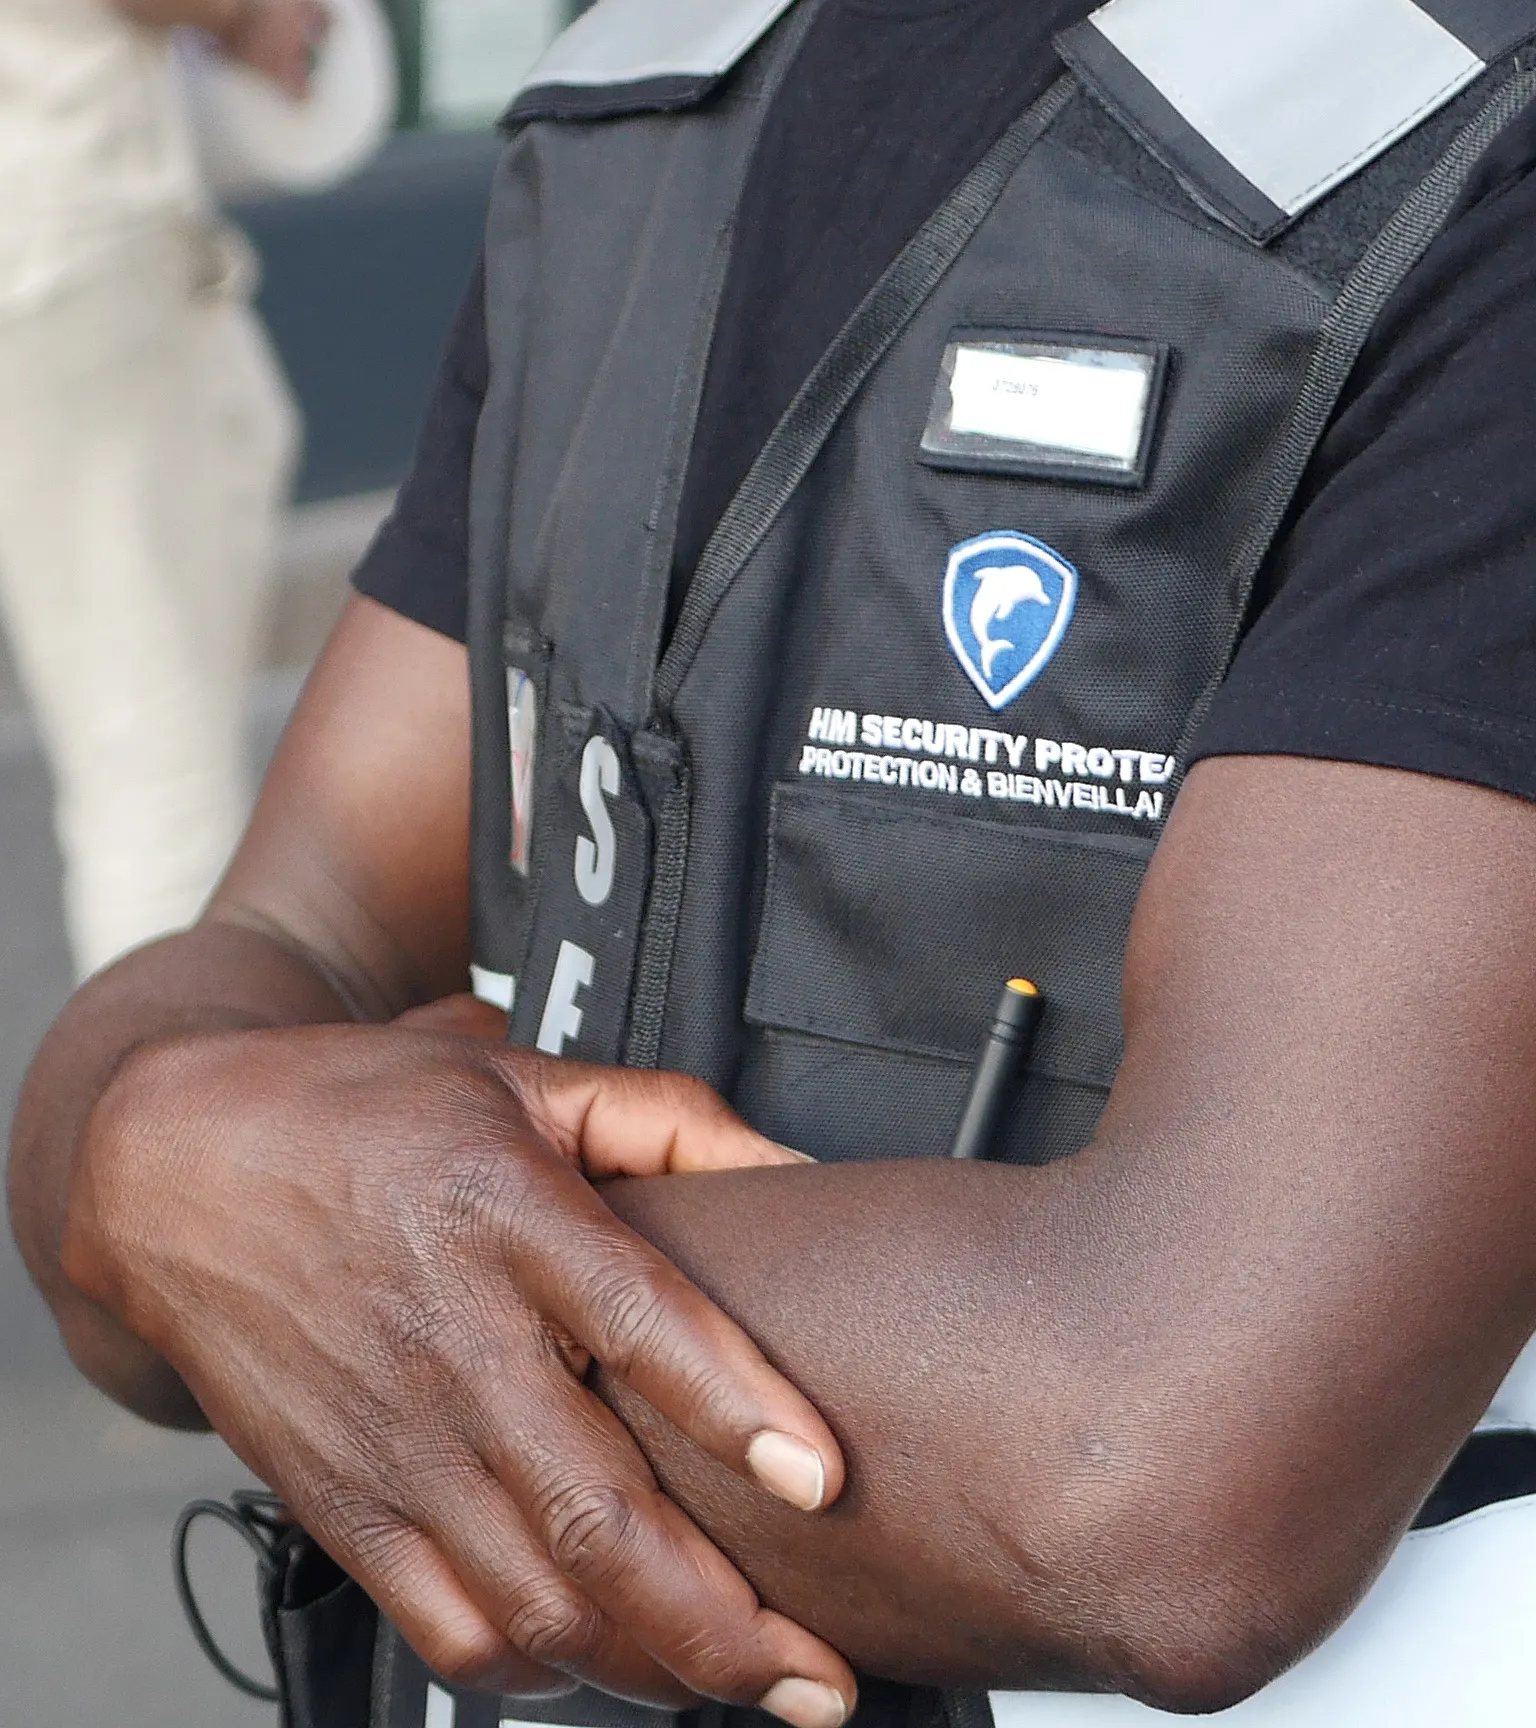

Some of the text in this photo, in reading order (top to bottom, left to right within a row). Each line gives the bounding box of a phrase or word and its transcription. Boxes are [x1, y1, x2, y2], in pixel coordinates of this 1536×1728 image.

[799, 745, 959, 793] PROTECTION
[961, 772, 983, 798] &
[807, 707, 1175, 783] HM SECURITY PROTE
